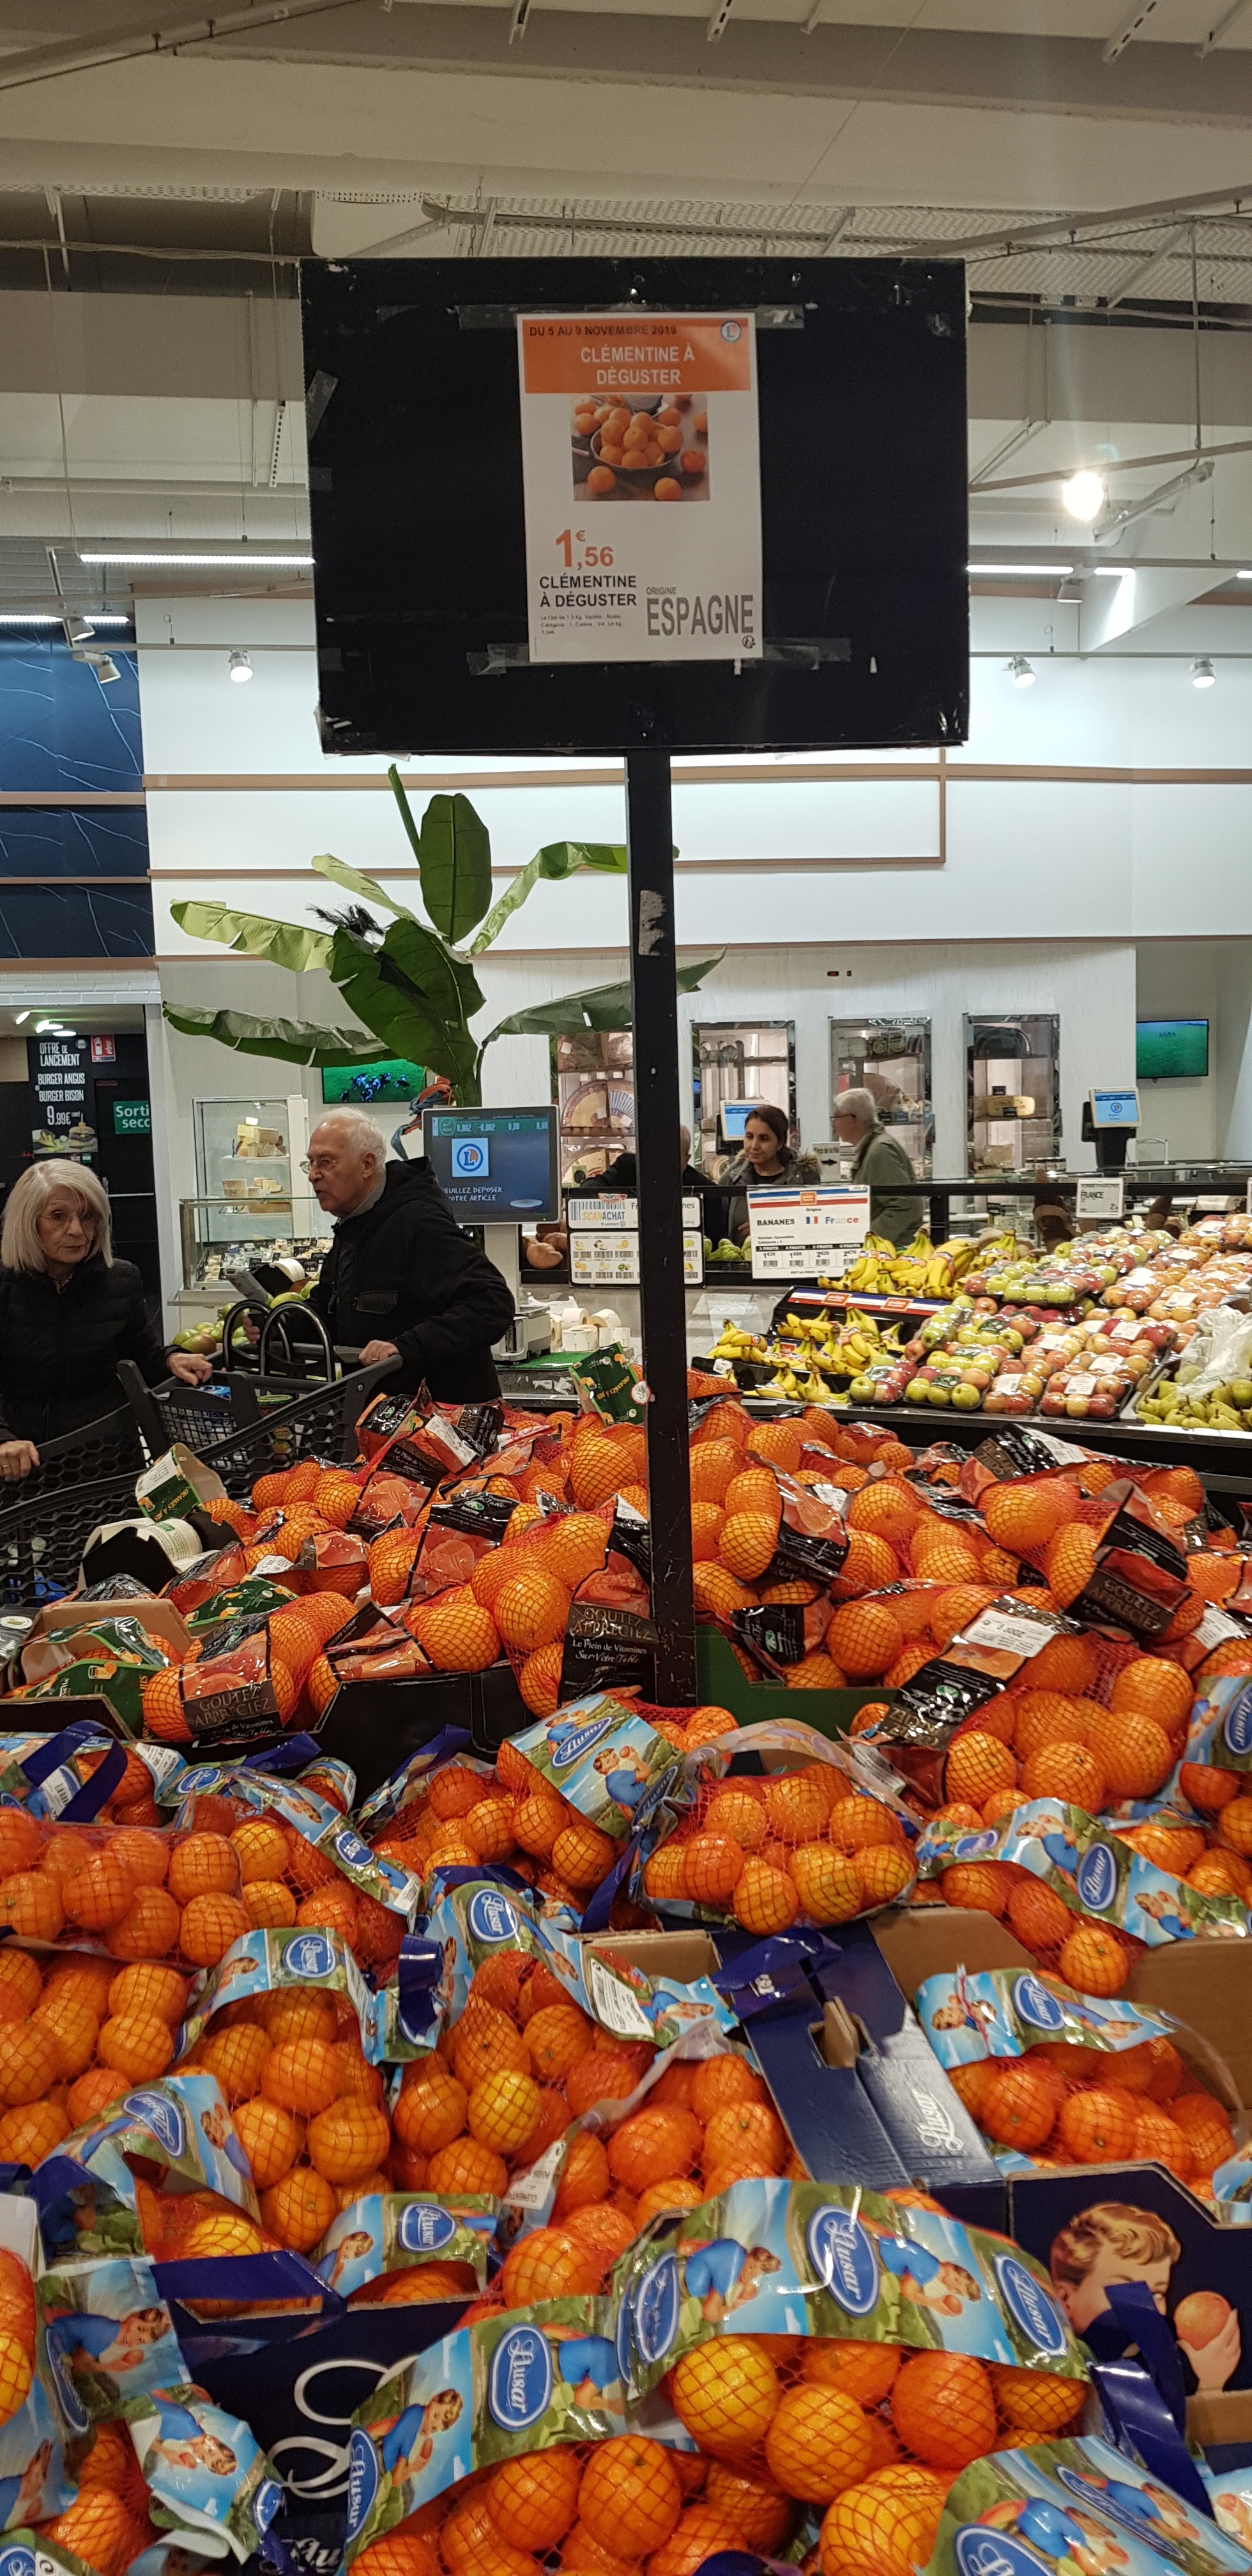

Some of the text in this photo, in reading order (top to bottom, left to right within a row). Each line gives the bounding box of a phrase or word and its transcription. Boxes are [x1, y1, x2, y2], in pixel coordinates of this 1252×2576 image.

[530, 326, 544, 336] DU
[548, 326, 554, 336] 5
[558, 326, 572, 335] AU
[576, 326, 581, 335] 9
[584, 325, 648, 335] NOVEMBRE
[580, 342, 695, 364] CLÉMENTINE À
[596, 365, 682, 385] DÉGUSTER
[539, 572, 637, 588] CLÉMENTINE
[539, 590, 637, 608] À DÉGUSTER
[645, 586, 678, 595] ORIGINE
[646, 594, 754, 636] ESPAGNE
[39, 1042, 68, 1054] OFFRE DE
[40, 1054, 80, 1067] LANCEMENT
[37, 1073, 86, 1085] BURGER ANGUS
[38, 1089, 84, 1102] BURGER BISON
[756, 1216, 859, 1227] BANANES France
[584, 1607, 642, 1627] GOUTEZ
[573, 1620, 656, 1641] APPRECIEZ
[572, 1639, 647, 1655] Le Plein de Vitamines
[482, 1894, 505, 1936] Llusar
[910, 2087, 963, 2152] Llusar
[822, 2218, 862, 2301] Llusar
[1007, 2266, 1054, 2349] Llusar
[505, 2337, 532, 2414] Llusar
[348, 2443, 366, 2529] Llusar
